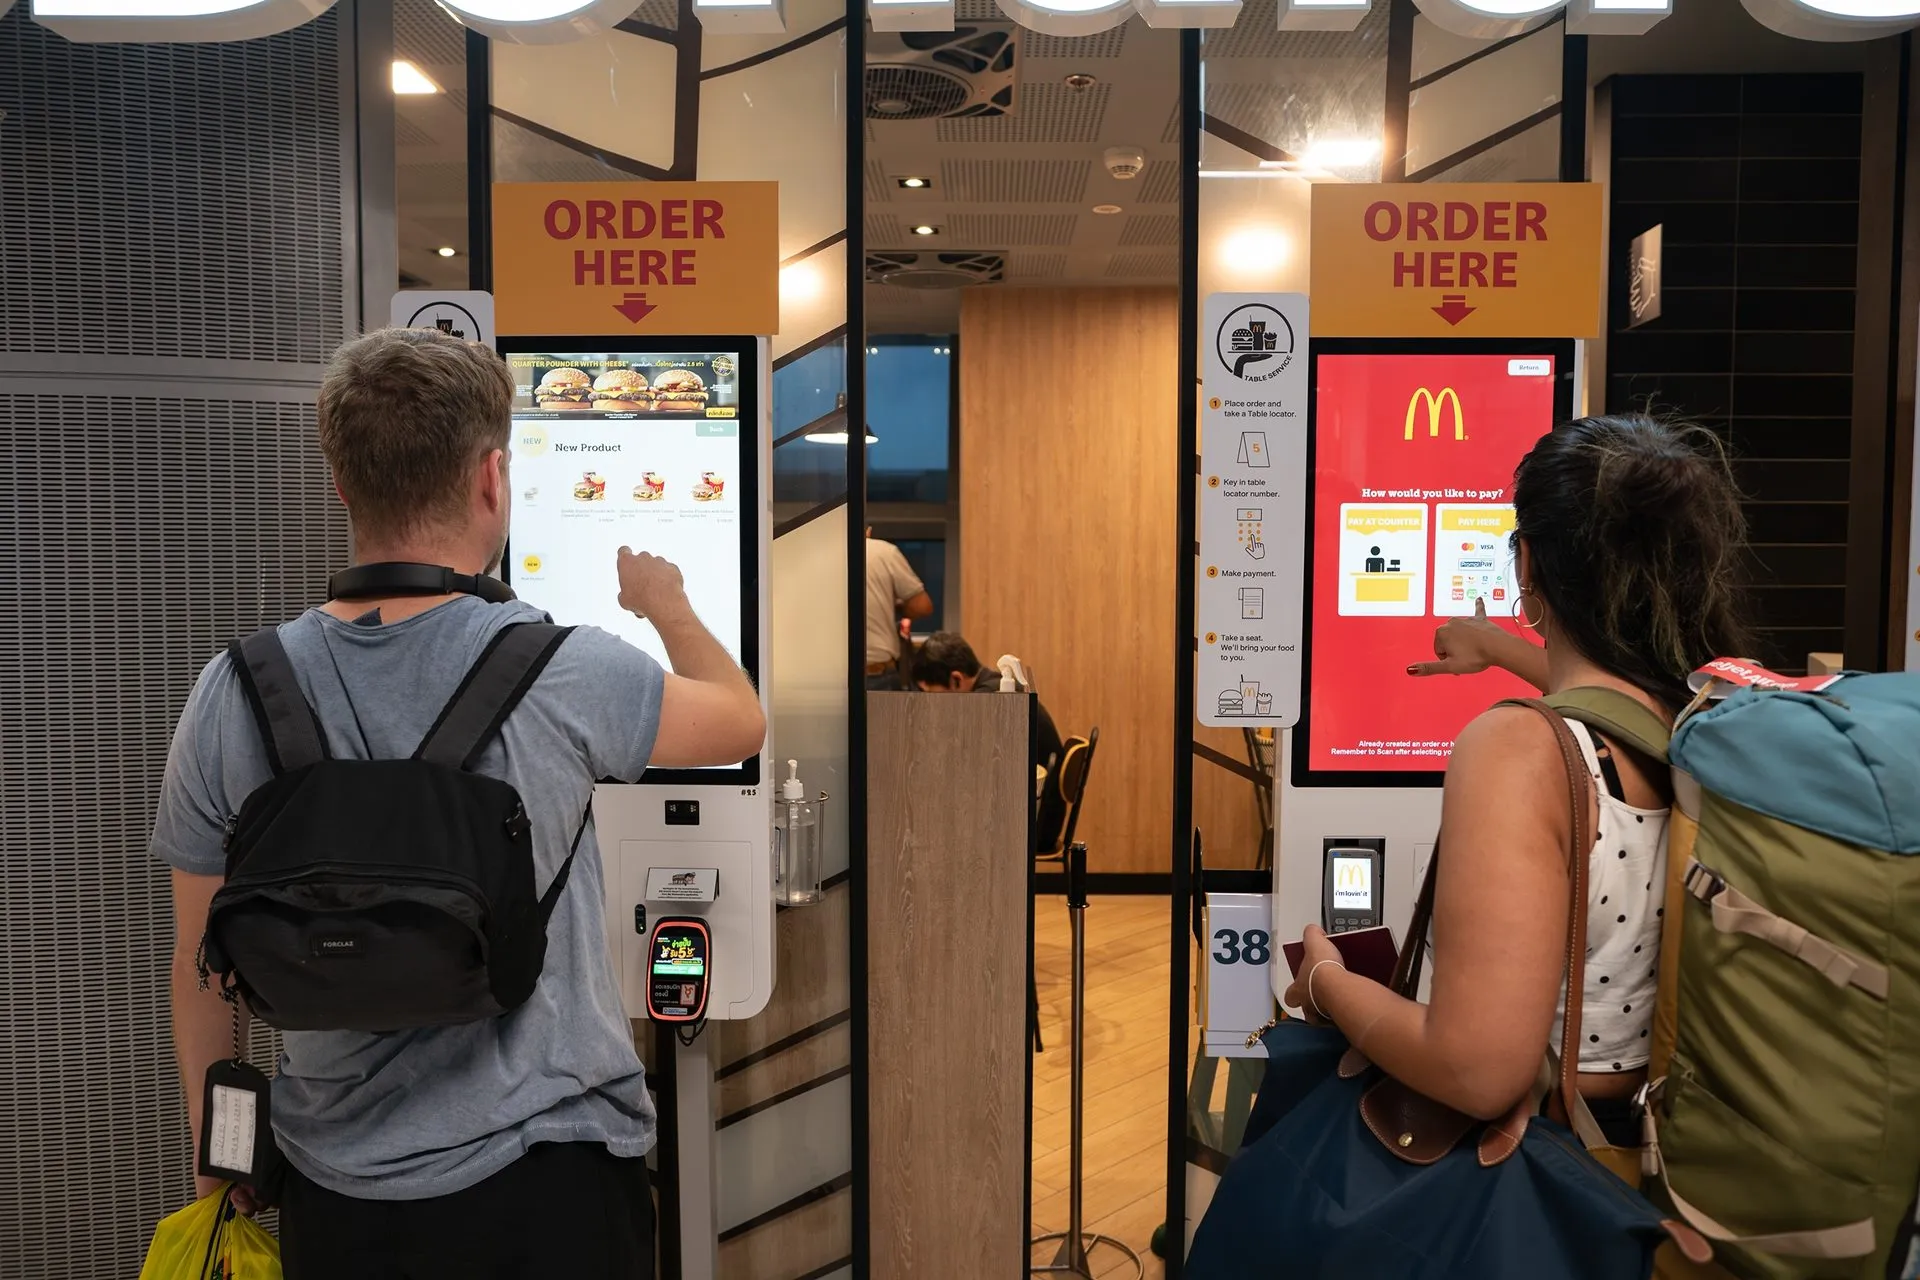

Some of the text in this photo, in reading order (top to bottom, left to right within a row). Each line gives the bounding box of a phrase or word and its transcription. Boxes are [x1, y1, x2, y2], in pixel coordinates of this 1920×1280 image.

[544, 200, 725, 240] ORDER
[1364, 201, 1548, 241] ORDER
[574, 250, 696, 286] HERE
[1393, 252, 1518, 287] HERE
[512, 360, 545, 368] QUARTER
[546, 360, 579, 368] POUNDER
[581, 360, 599, 368] WITH
[1268, 355, 1292, 379] SERVICE
[555, 443, 621, 452] New Product
[1253, 444, 1260, 453] 5
[1223, 478, 1238, 487] Key
[1362, 488, 1504, 500] How would you like to pay?
[1348, 517, 1420, 526] PAY AT COUNTER
[1458, 518, 1500, 526] PAY HERE
[1243, 570, 1277, 578] payment.
[1240, 644, 1259, 652] bring
[1260, 645, 1276, 653] your
[1229, 655, 1245, 663] you.
[1358, 740, 1384, 748] Already
[1411, 748, 1442, 756] selecting
[1213, 929, 1270, 966] 38
